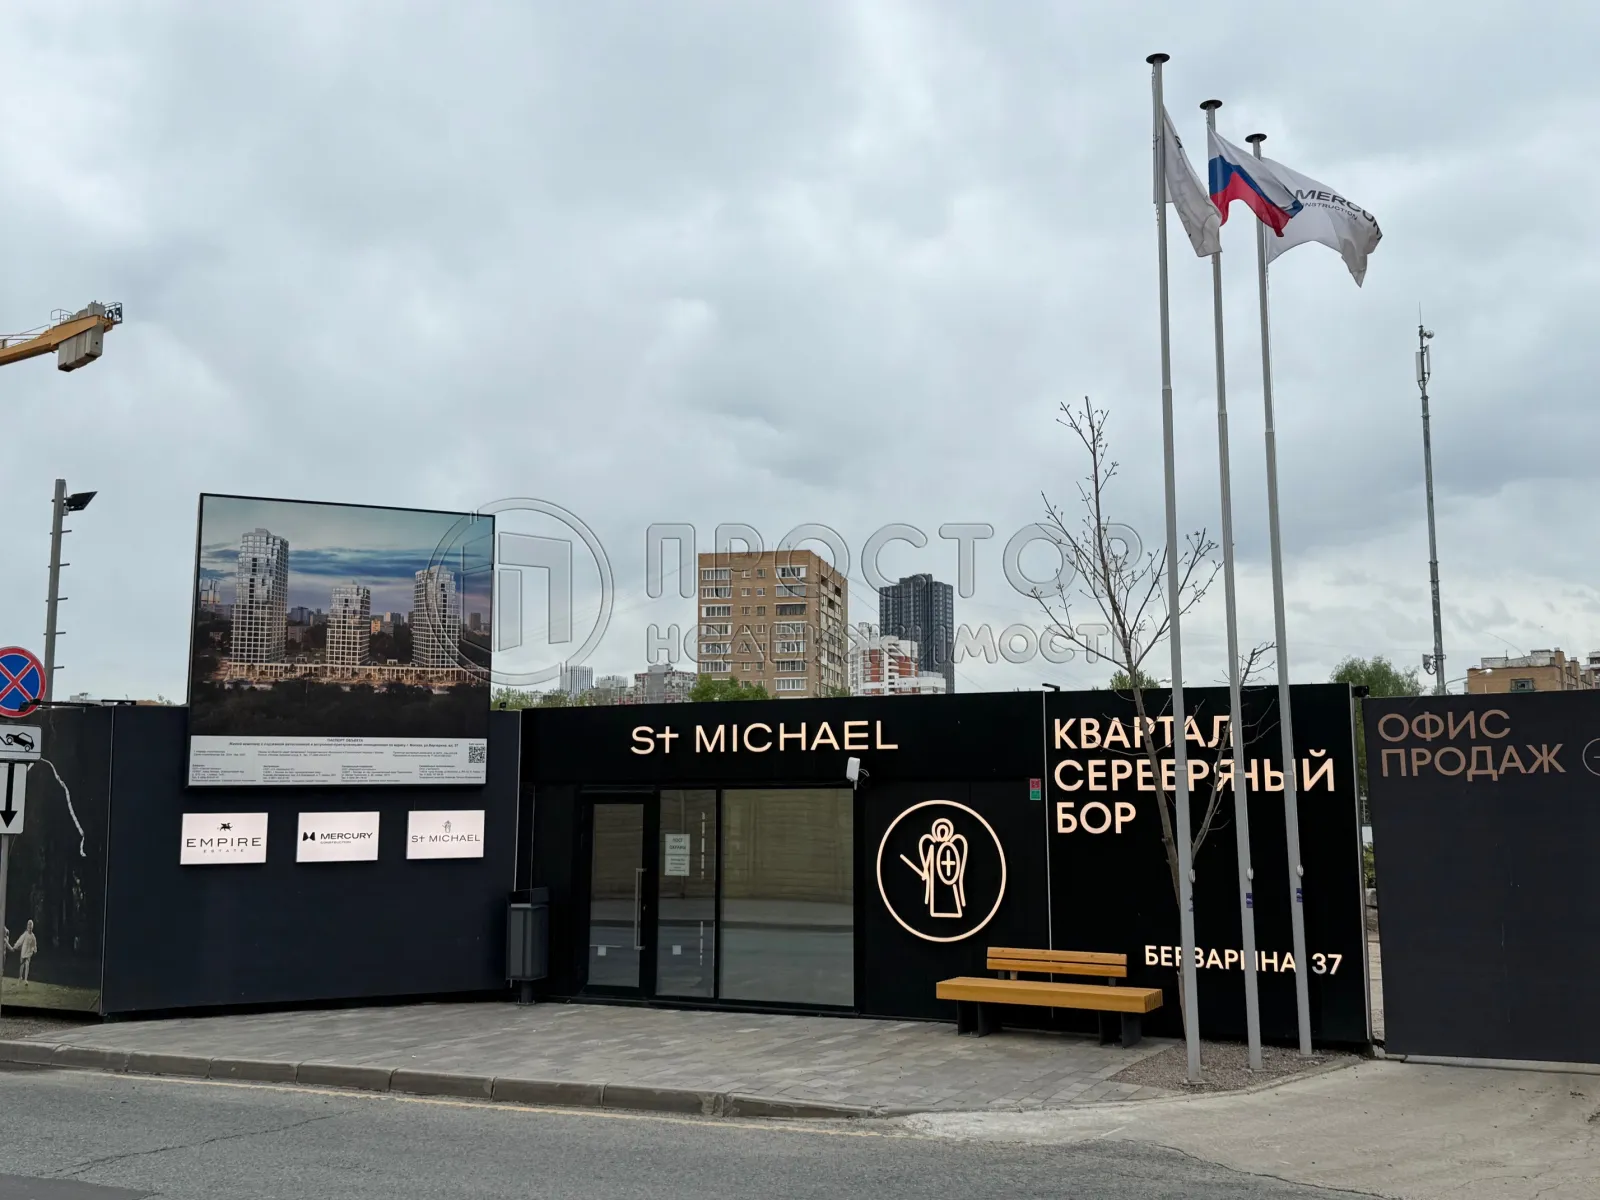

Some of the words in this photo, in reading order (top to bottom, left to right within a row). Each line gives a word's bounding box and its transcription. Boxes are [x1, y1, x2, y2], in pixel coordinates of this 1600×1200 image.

[1295, 189, 1382, 240] MERCU
[1302, 202, 1358, 221] NSTRUCTION
[630, 725, 679, 755] St
[695, 720, 899, 753] MICHAEL
[1054, 715, 1234, 750] КВАРТАЛ
[1377, 709, 1511, 742] ОФИС
[1054, 749, 1336, 792] СЕРЕБРЯНЫЙ
[1381, 743, 1567, 782] ПРОДАЖ
[1056, 801, 1137, 834] БОР
[186, 837, 262, 848] EMPIRE
[320, 832, 373, 840] MERCURY
[428, 834, 480, 843] MICHAEL
[1311, 952, 1343, 976] 37
